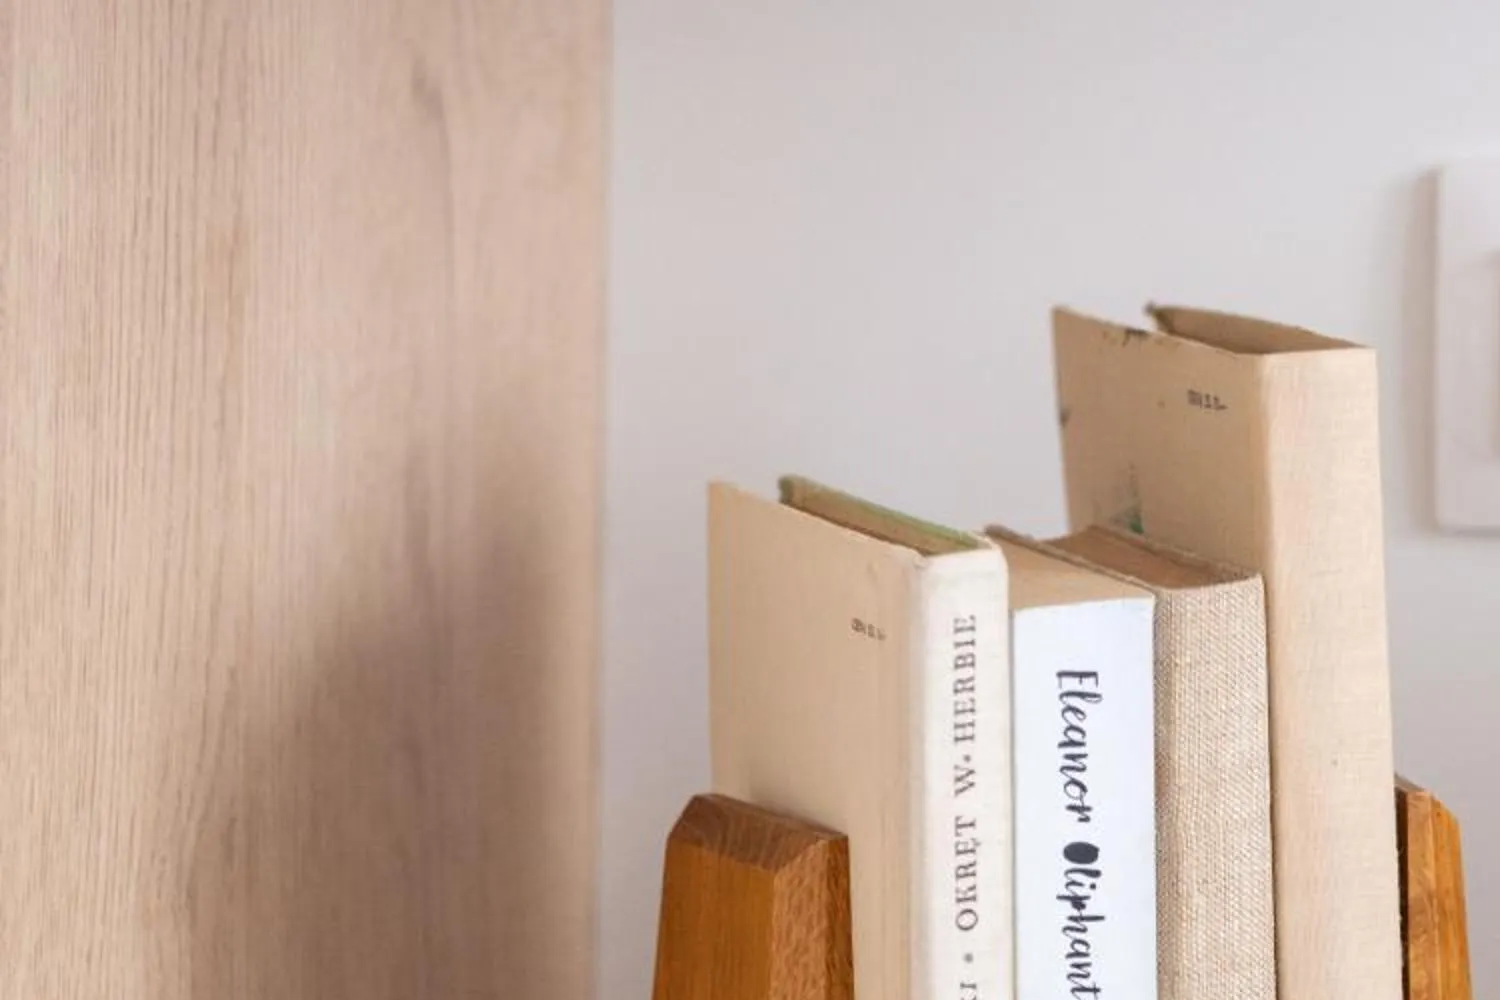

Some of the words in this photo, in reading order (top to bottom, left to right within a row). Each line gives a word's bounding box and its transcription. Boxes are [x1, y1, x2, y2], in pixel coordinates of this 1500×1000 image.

[953, 614, 977, 744] HERBIE
[1056, 670, 1103, 823] Eleanor
[955, 816, 982, 931] OKRĘT
